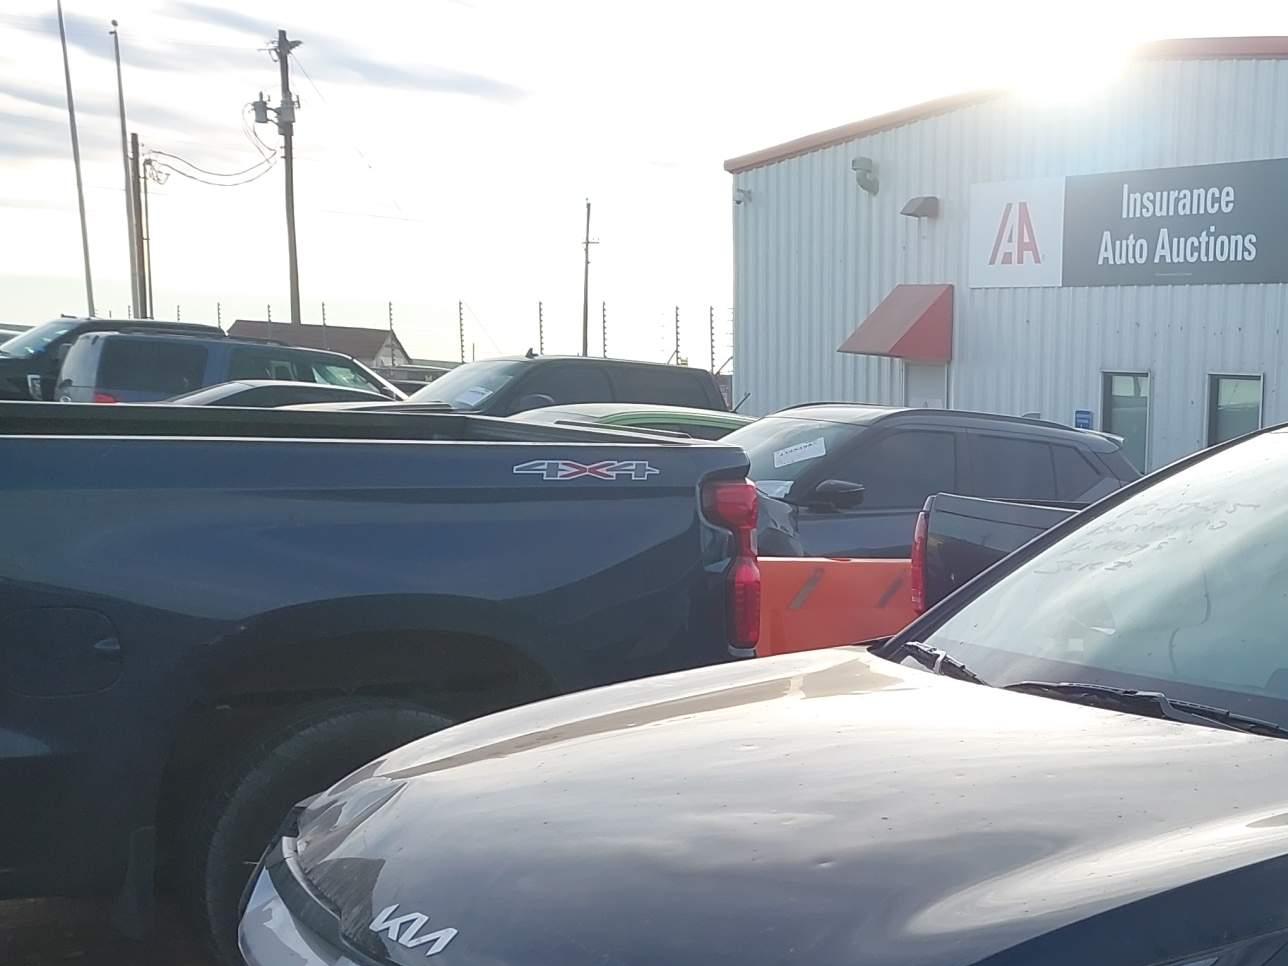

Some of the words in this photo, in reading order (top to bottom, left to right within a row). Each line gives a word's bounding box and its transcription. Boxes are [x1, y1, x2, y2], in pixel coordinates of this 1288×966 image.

[1121, 183, 1235, 219] Insurance
[1097, 230, 1149, 265] Auto
[1153, 225, 1258, 264] Auctions
[369, 903, 459, 957] KIA
